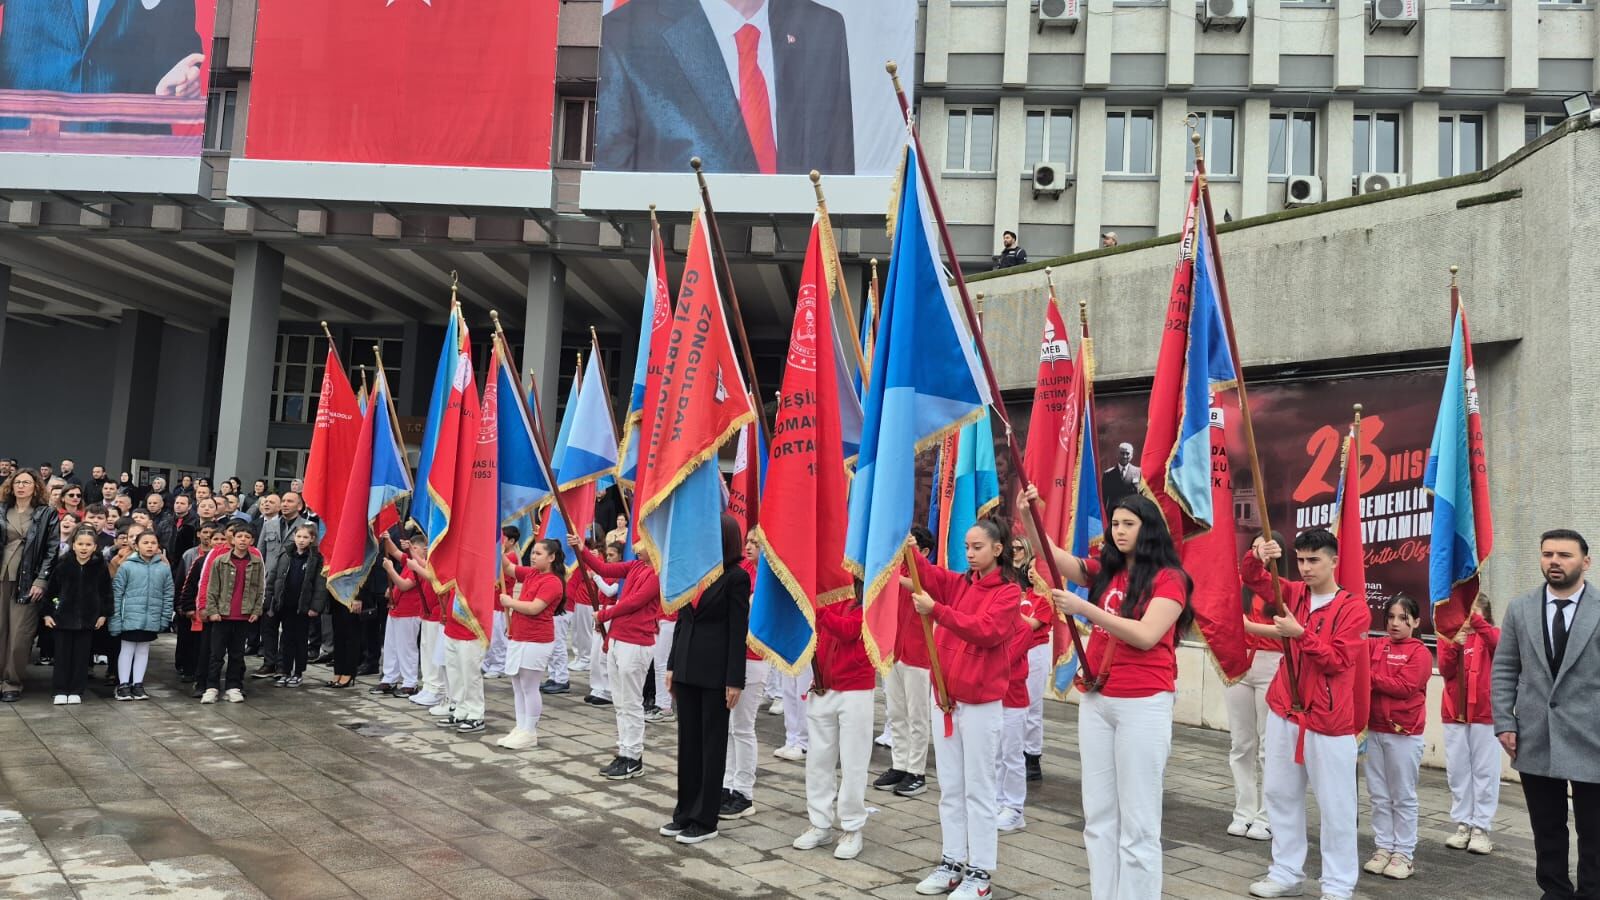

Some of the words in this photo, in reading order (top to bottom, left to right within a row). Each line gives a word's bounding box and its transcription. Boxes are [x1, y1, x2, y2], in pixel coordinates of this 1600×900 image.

[675, 269, 699, 322] GAZİ
[671, 303, 712, 441] ZONGULDAK
[648, 330, 683, 469] ORTAOK
[780, 388, 817, 411] EŞİL
[774, 439, 817, 459] ORTA
[1293, 415, 1386, 502] 23
[1389, 448, 1430, 483] NİS
[474, 470, 492, 479] 1953
[1360, 487, 1428, 518] EMENLİK
[1361, 512, 1432, 544] YRAMIM
